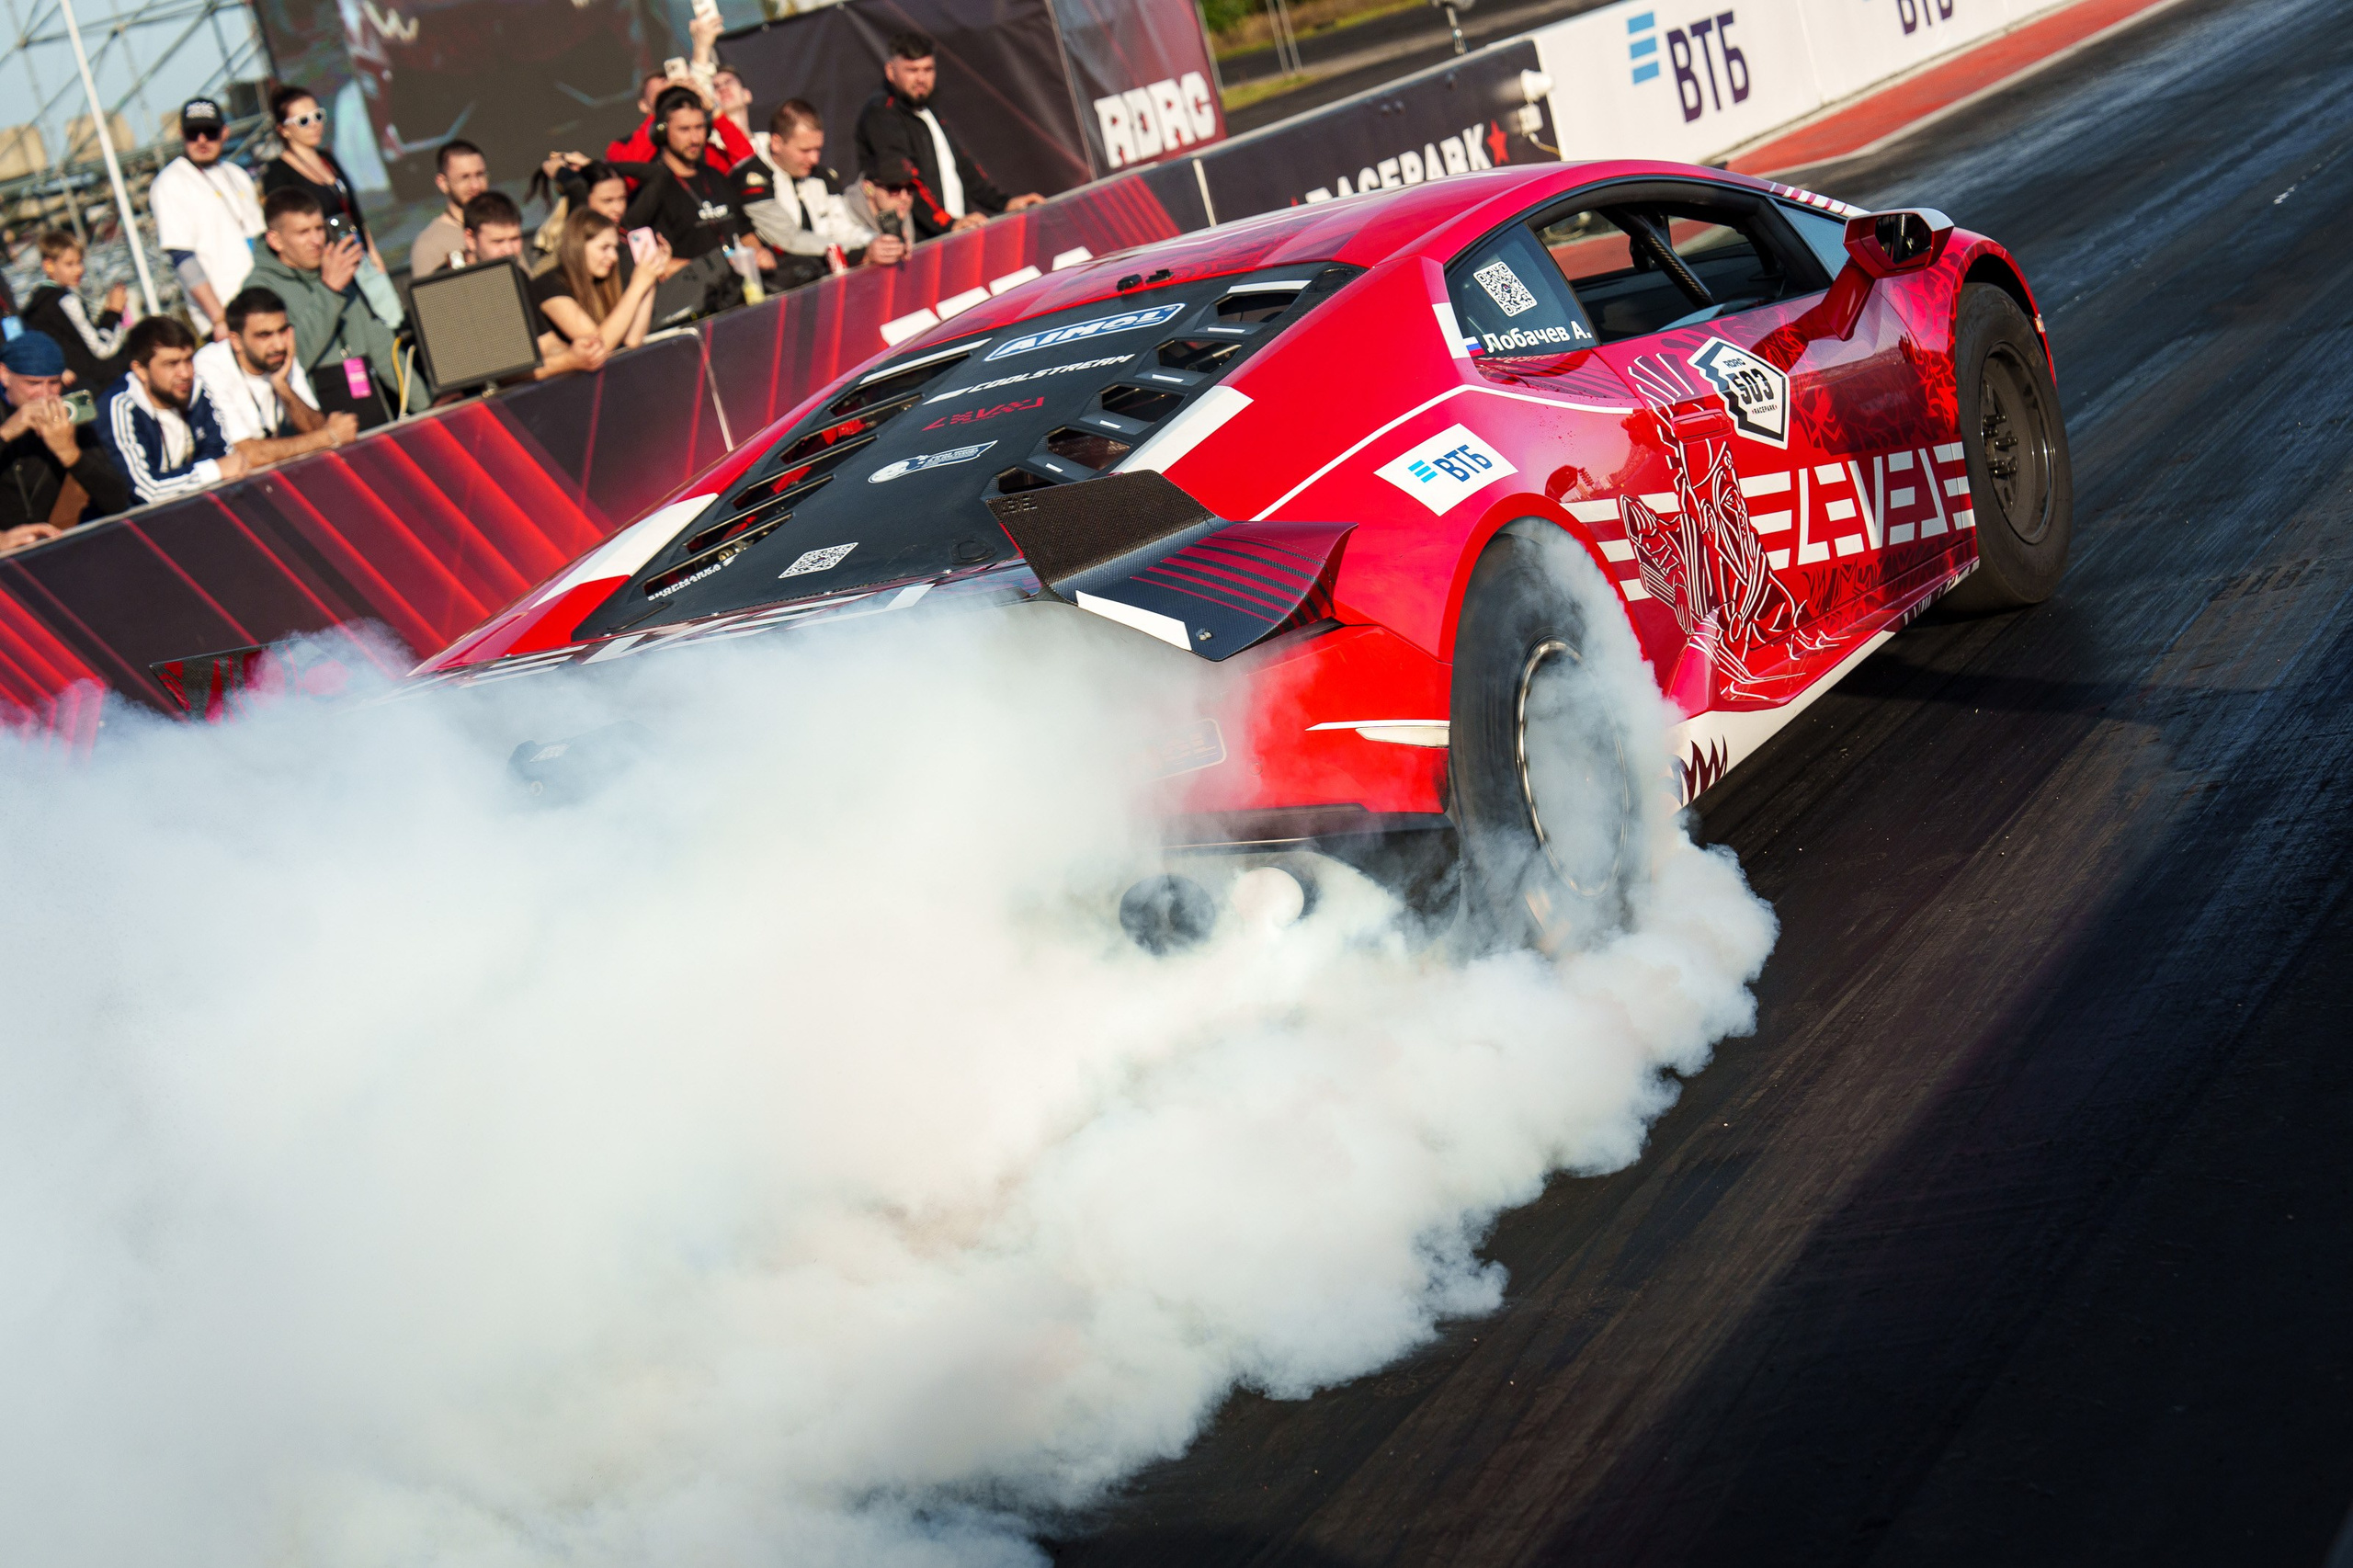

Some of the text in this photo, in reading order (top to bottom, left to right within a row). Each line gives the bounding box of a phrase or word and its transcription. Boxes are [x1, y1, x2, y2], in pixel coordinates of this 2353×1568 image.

[1665, 8, 1751, 123] ВТБ
[1093, 71, 1218, 169] RDRC
[1482, 320, 1593, 354] Лобачев А.
[968, 353, 1136, 394] COOLSTREAM
[1725, 368, 1775, 405] 503
[1753, 404, 1776, 415] RACEPARK
[1431, 444, 1494, 483] ВТБ
